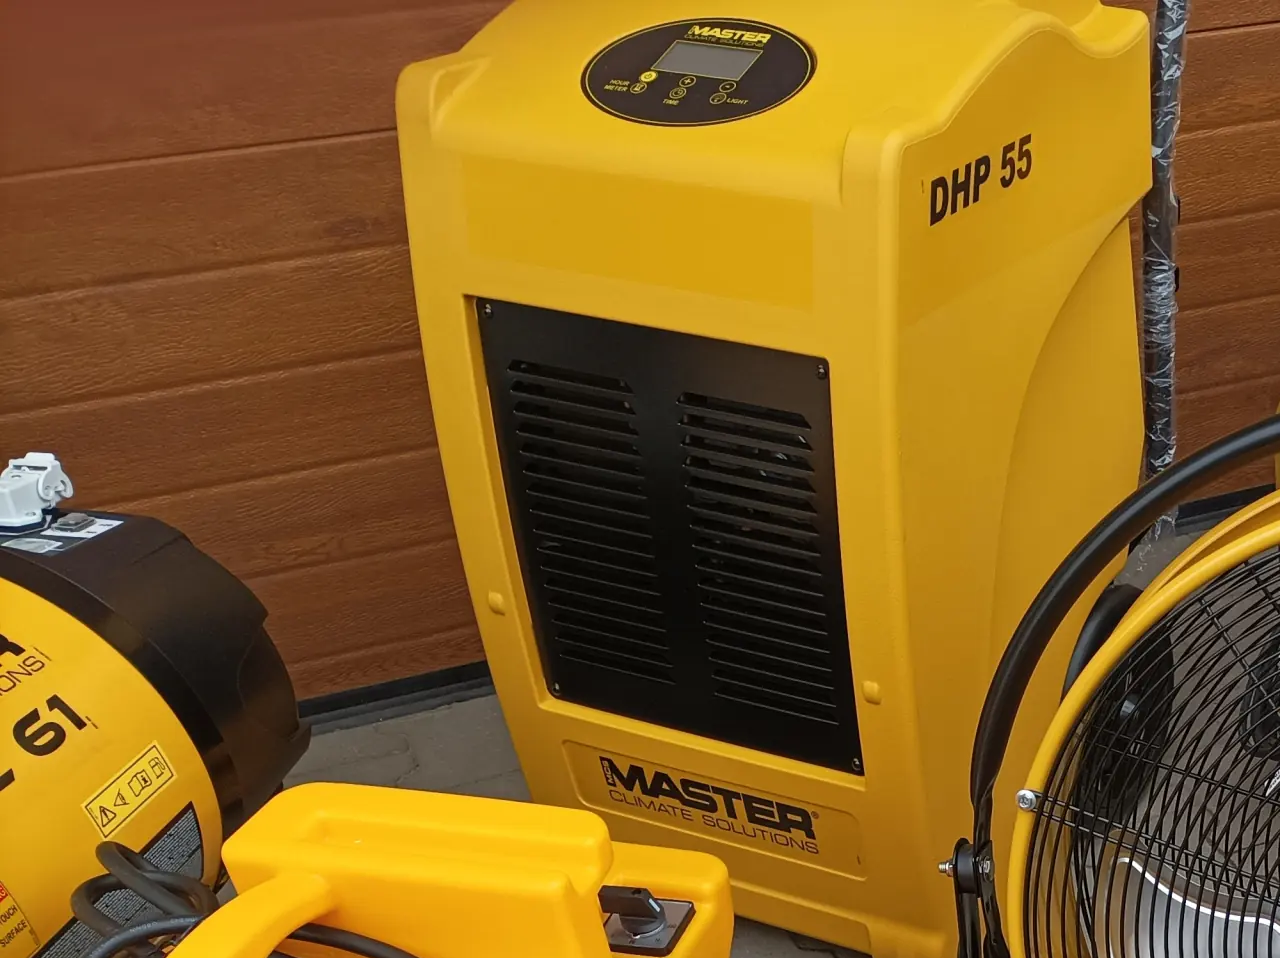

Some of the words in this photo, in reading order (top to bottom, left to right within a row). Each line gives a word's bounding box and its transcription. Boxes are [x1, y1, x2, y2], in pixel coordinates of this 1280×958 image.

[684, 33, 718, 43] CLIMATE
[694, 25, 771, 43] MASTER
[604, 84, 628, 92] METER
[662, 98, 680, 106] TIME
[726, 98, 749, 106] LIGHT
[930, 155, 991, 227] DHP
[1000, 133, 1032, 188] 55
[13, 694, 87, 757] 61
[606, 757, 816, 840] MASTER
[609, 789, 694, 822] CLIMATE
[702, 814, 819, 855] SOLUTIONS
